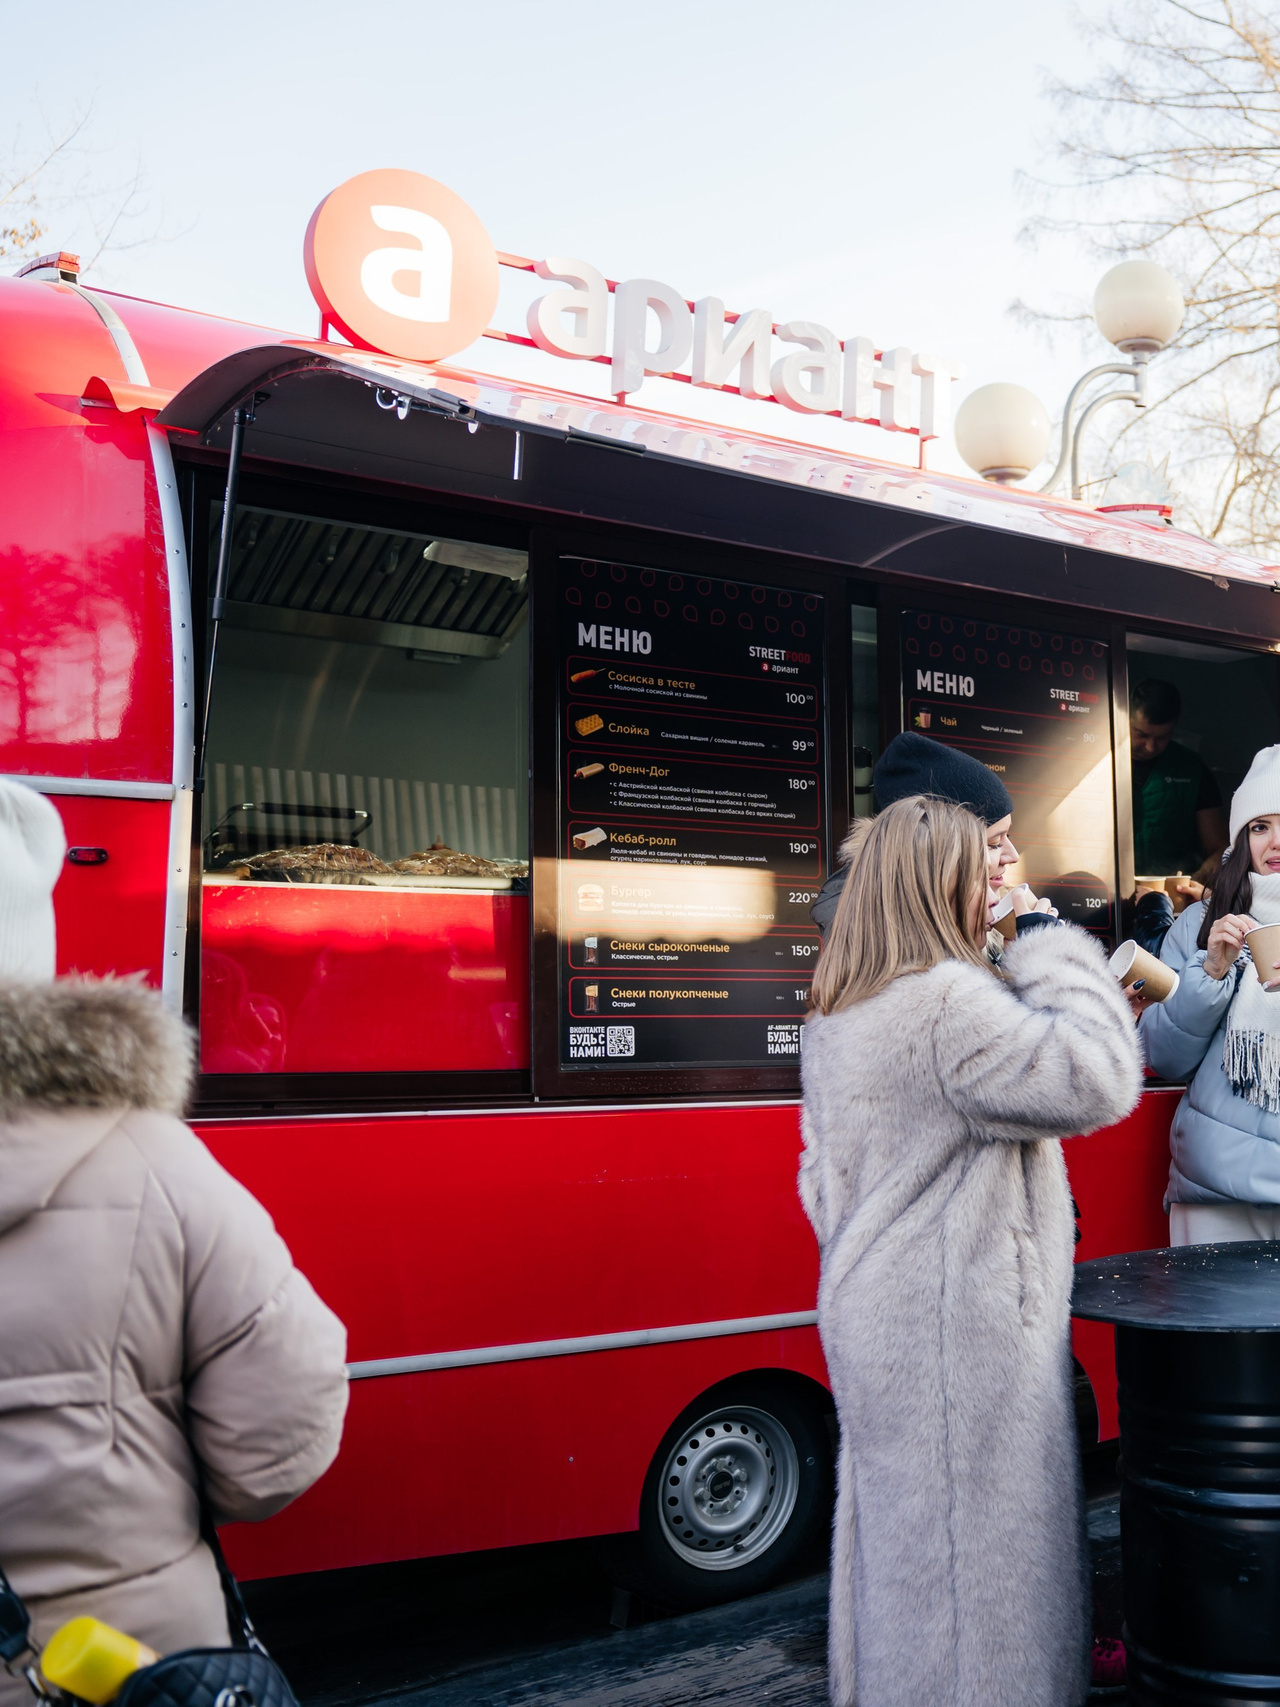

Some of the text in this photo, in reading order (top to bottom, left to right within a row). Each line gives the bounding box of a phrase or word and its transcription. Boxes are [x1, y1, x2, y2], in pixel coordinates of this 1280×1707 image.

[526, 257, 962, 439] ариант
[578, 622, 652, 655] МЕНЮ
[772, 664, 799, 674] ариант
[608, 671, 654, 685] Сосиска
[667, 680, 696, 690] тесте
[916, 669, 975, 698] МЕНЮ
[614, 684, 645, 692] Молочной
[646, 688, 674, 696] сосиской
[1050, 688, 1099, 705] STREET
[1069, 705, 1090, 713] ариант
[940, 715, 957, 727] Чай
[608, 723, 650, 736] Слойка
[661, 732, 689, 740] Сахарная
[738, 740, 765, 748] карамель
[609, 763, 670, 778] Френч-Дог
[618, 782, 658, 790] Австрийской
[618, 791, 659, 799] Французской
[618, 800, 660, 809] Классической
[610, 832, 676, 846] Кебаб-ролл
[610, 848, 648, 856] Люля-кебаб
[611, 885, 652, 898] Бургер
[610, 940, 730, 953] Снеки сырокопченые
[611, 988, 728, 1000] Снеки полукопченые
[570, 1034, 605, 1046] БУДЬ С
[768, 1032, 798, 1043] БУДЬ С
[570, 1046, 605, 1057] НАМИ!
[768, 1044, 798, 1054] НАМИ!
